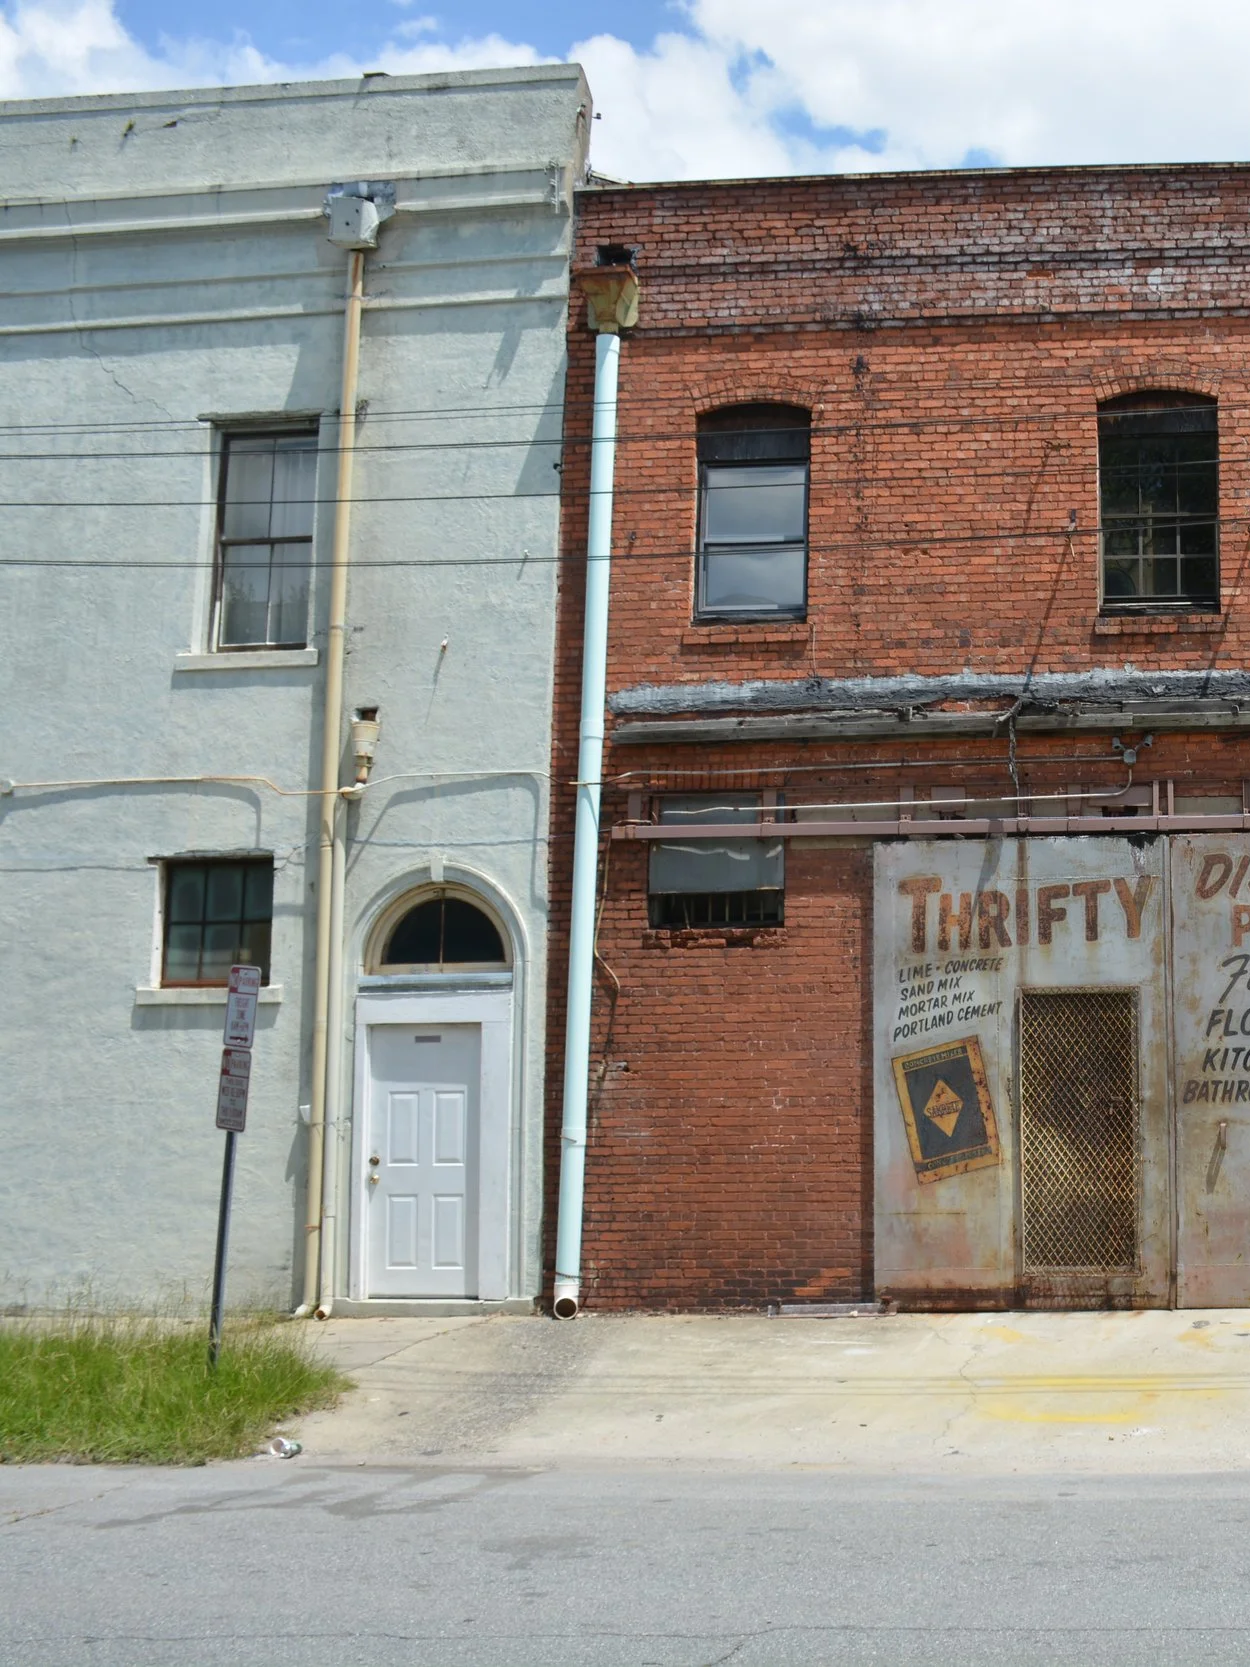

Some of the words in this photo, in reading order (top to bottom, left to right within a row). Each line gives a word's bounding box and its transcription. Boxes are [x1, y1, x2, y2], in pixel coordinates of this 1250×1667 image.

[899, 874, 1159, 954] THRIFTY
[899, 963, 933, 983] LIME
[945, 957, 1004, 975] CONCRETE
[900, 980, 934, 1001] SAND
[937, 975, 963, 992] MIX
[898, 995, 948, 1020] MORTAR
[951, 990, 976, 1006] MIX
[893, 1010, 954, 1042] PORTLAND
[957, 1001, 1003, 1022] CEMENT
